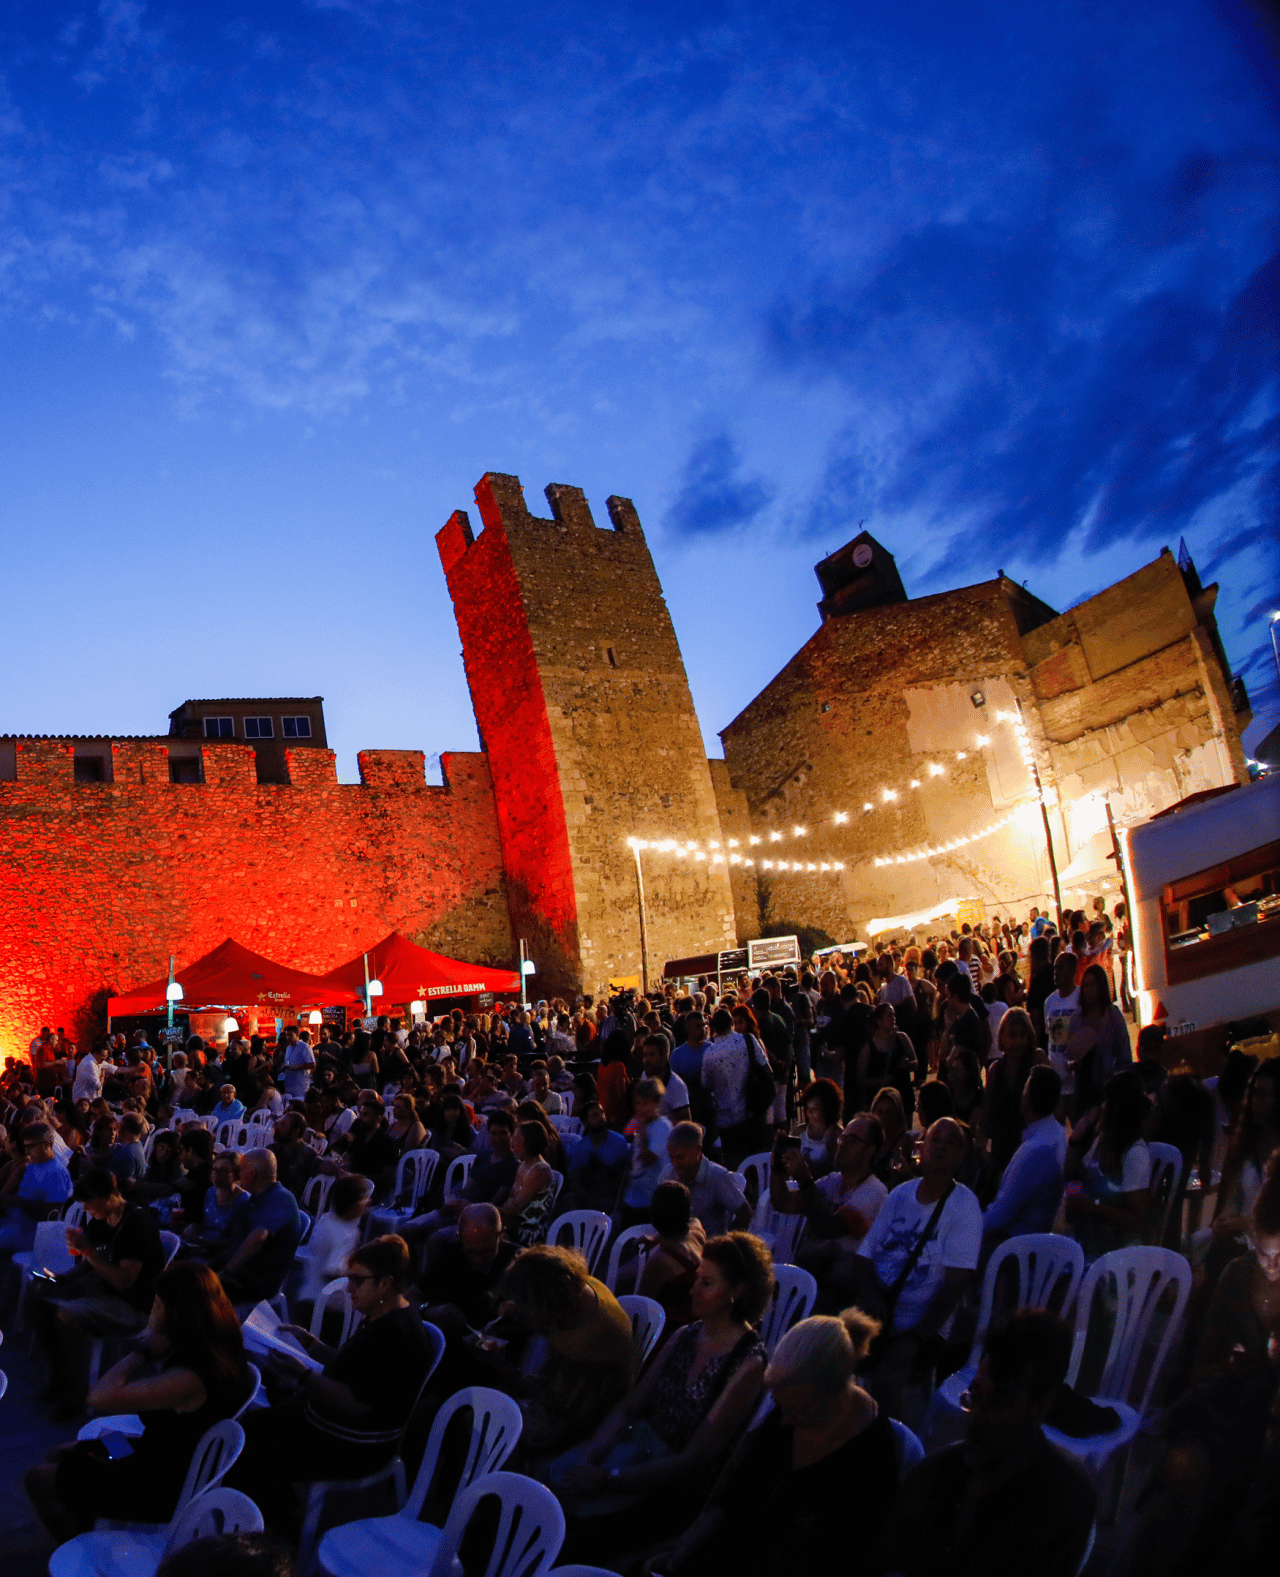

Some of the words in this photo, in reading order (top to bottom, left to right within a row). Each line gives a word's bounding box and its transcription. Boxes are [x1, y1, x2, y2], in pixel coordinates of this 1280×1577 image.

[428, 984, 463, 996] ESTRELLA
[463, 983, 487, 993] DAMM
[267, 991, 291, 999] Estrella
